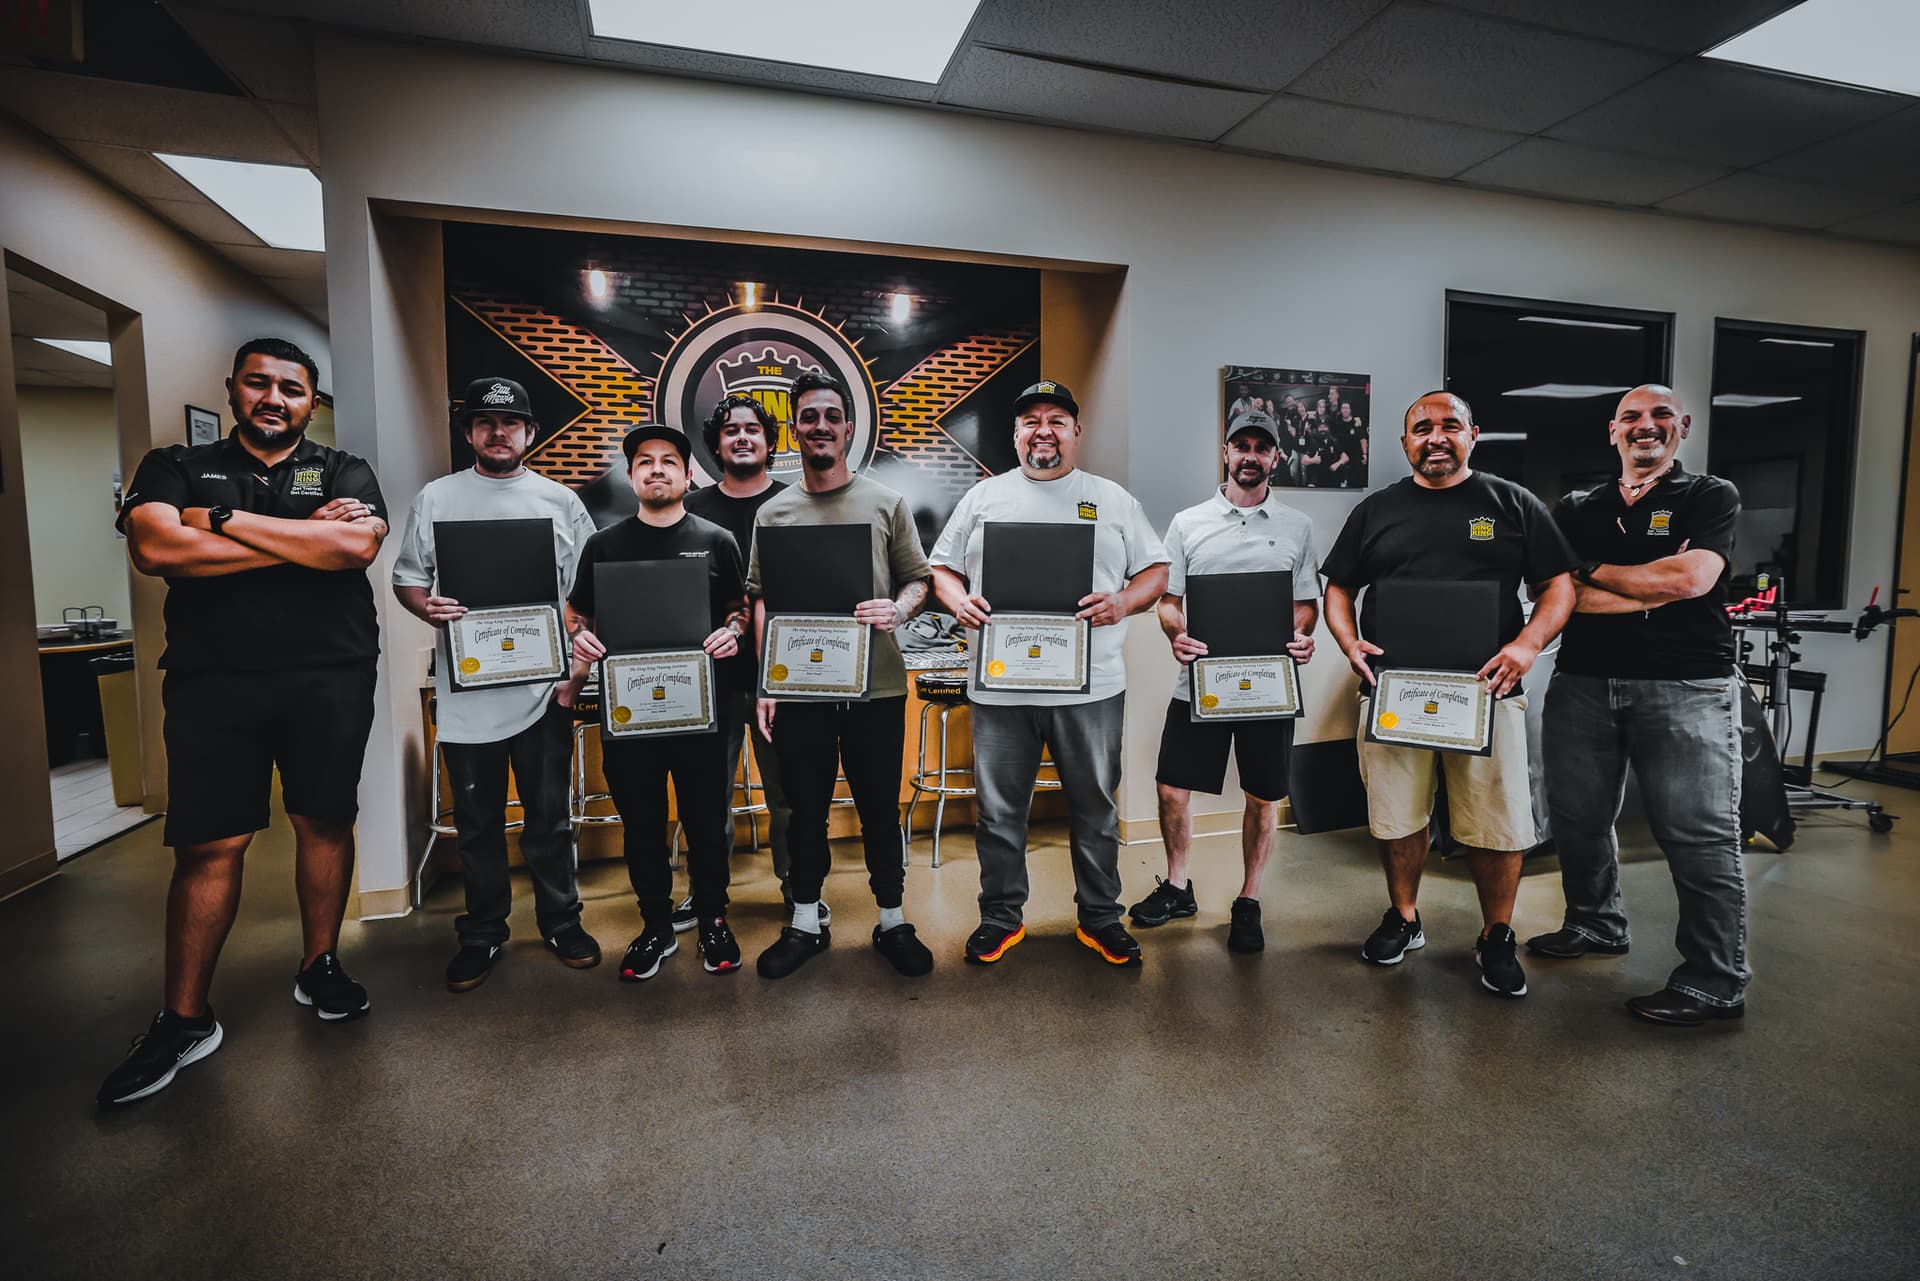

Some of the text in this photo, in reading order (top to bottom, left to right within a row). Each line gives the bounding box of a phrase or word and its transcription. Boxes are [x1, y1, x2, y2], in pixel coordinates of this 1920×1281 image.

[757, 365, 783, 375] THE
[474, 624, 540, 644] Certificate of Completion
[1006, 633, 1068, 648] Certificate of Completion
[788, 635, 850, 652] Certificate of Completion
[628, 672, 692, 692] Certificate of Completion
[1216, 668, 1276, 683] Certificate of Completion
[1399, 688, 1469, 706] Certificate of Completion
[578, 703, 599, 711] Cert
